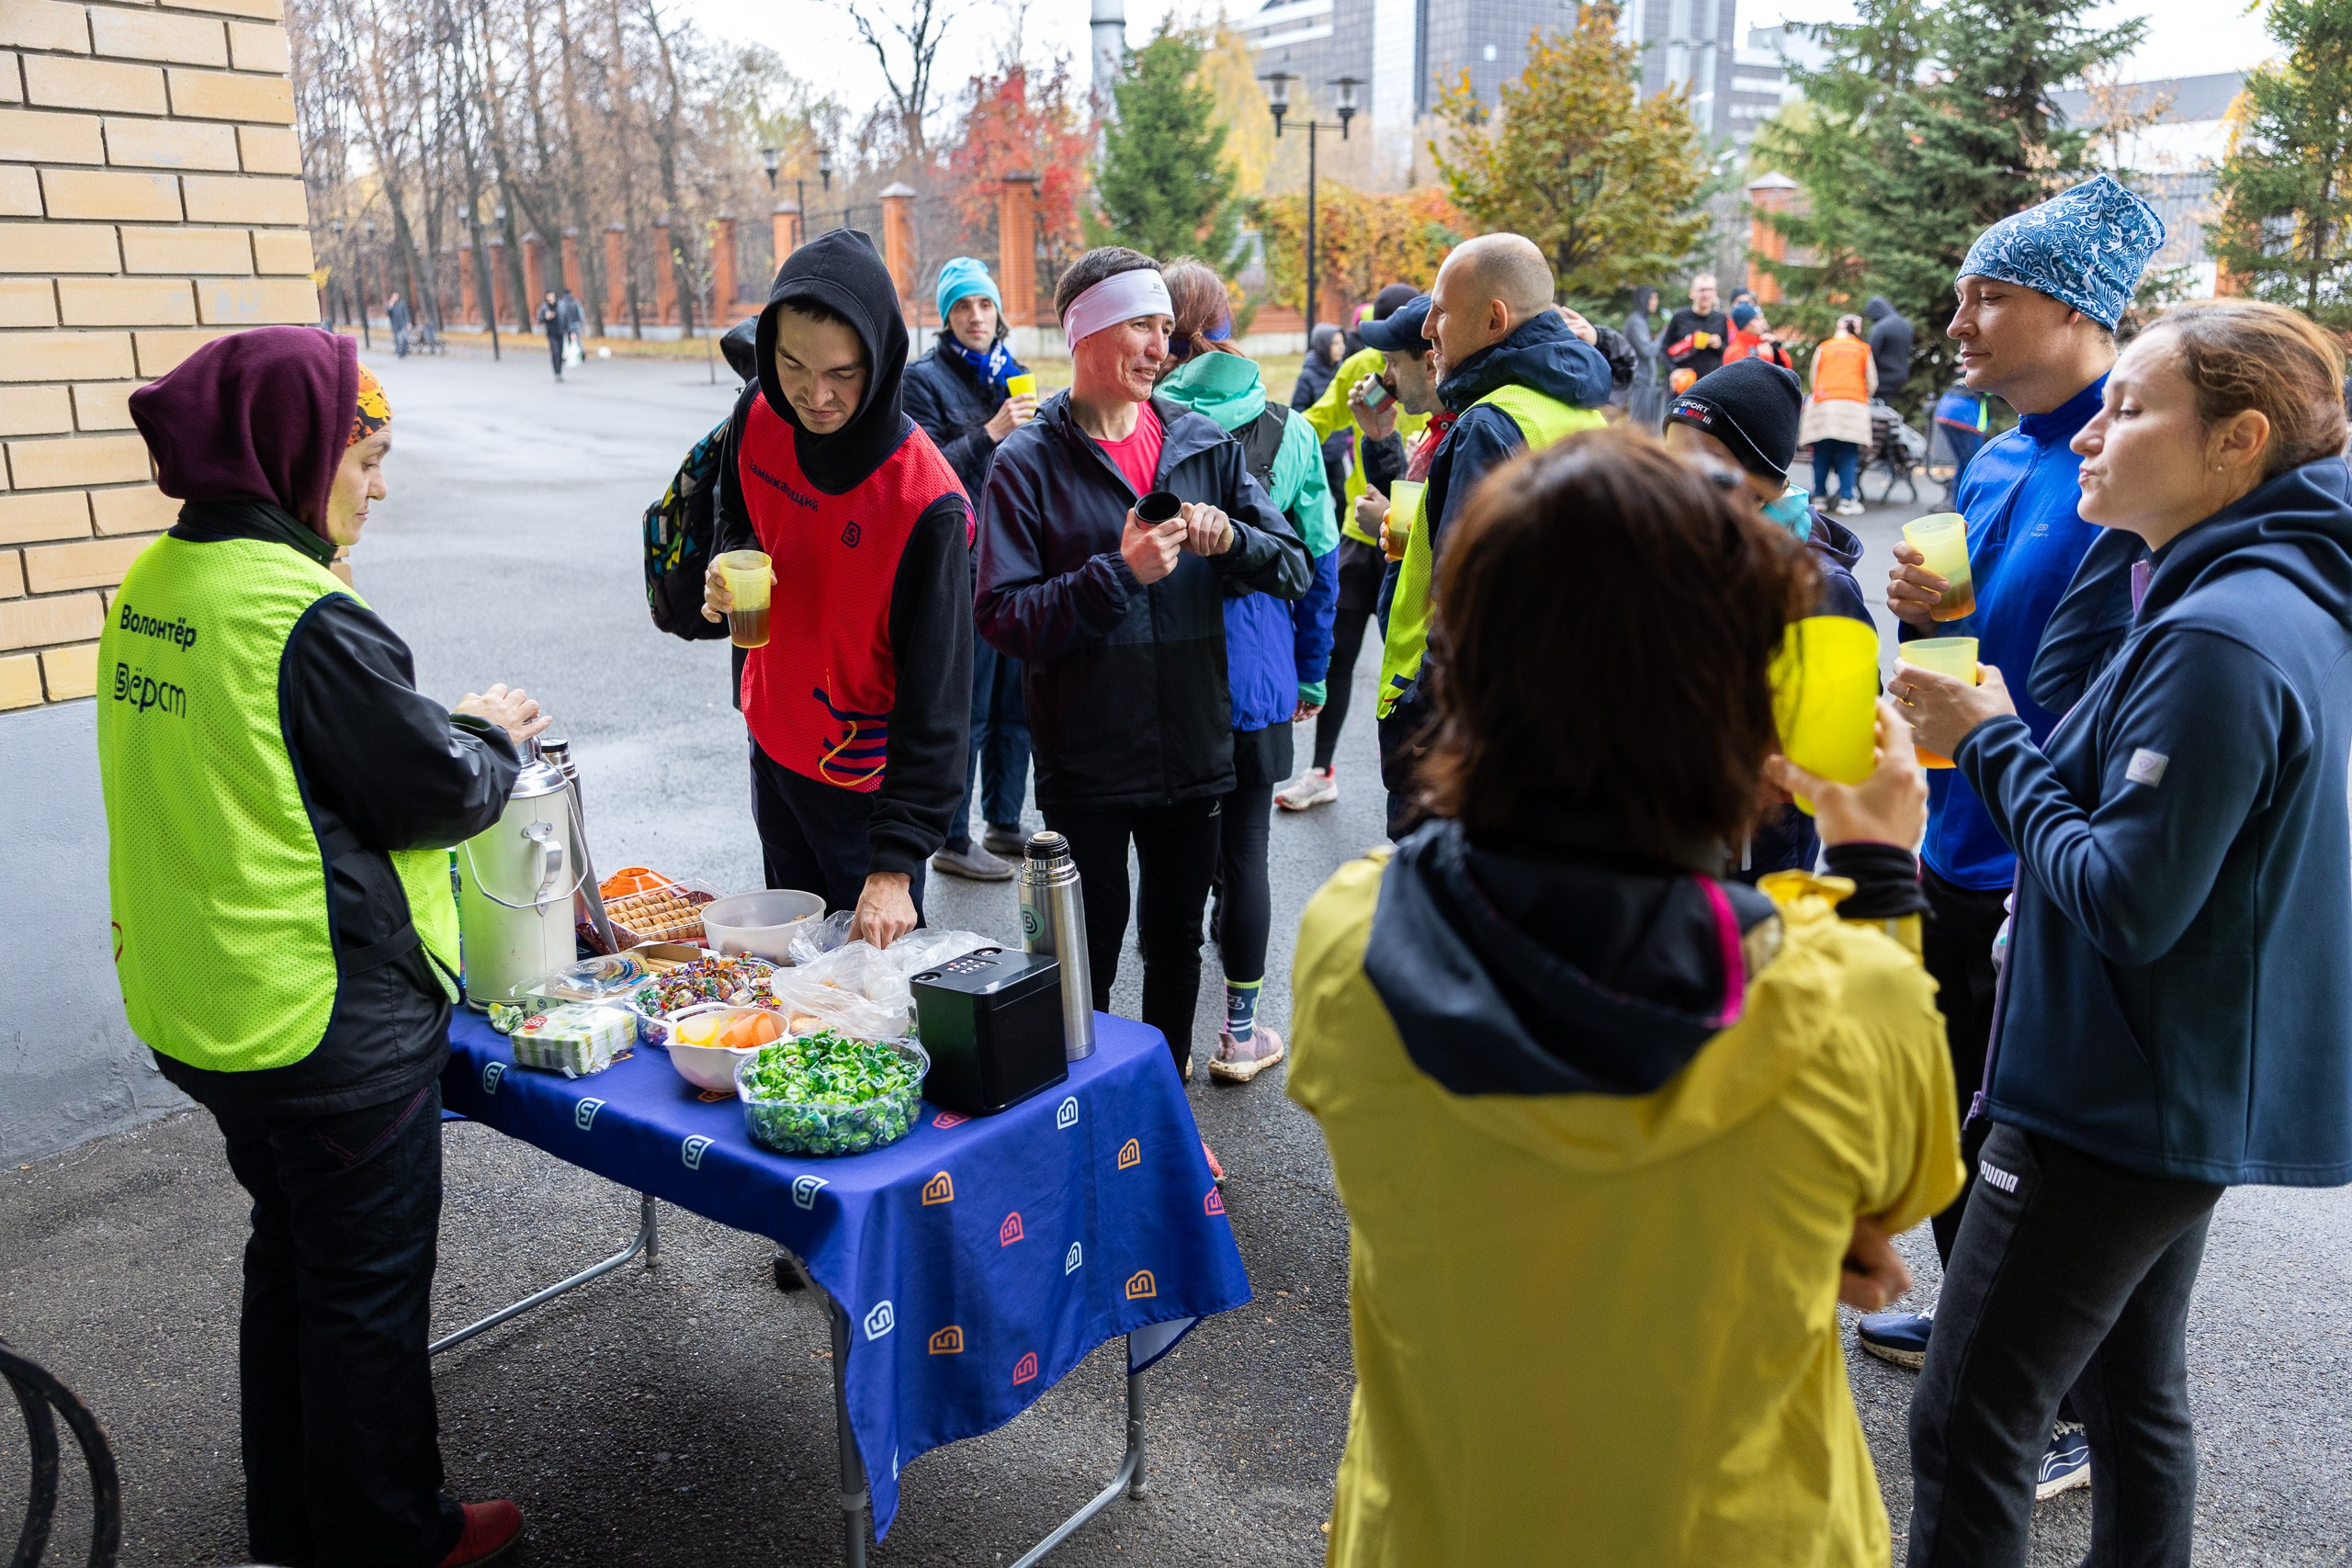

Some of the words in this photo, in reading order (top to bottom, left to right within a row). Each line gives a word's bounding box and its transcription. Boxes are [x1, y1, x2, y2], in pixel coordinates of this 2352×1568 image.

[1680, 400, 1710, 413] SPORT
[119, 604, 198, 653] Волонтёр
[527, 1019, 545, 1027] 365
[1980, 1159, 2018, 1193] PUMA
